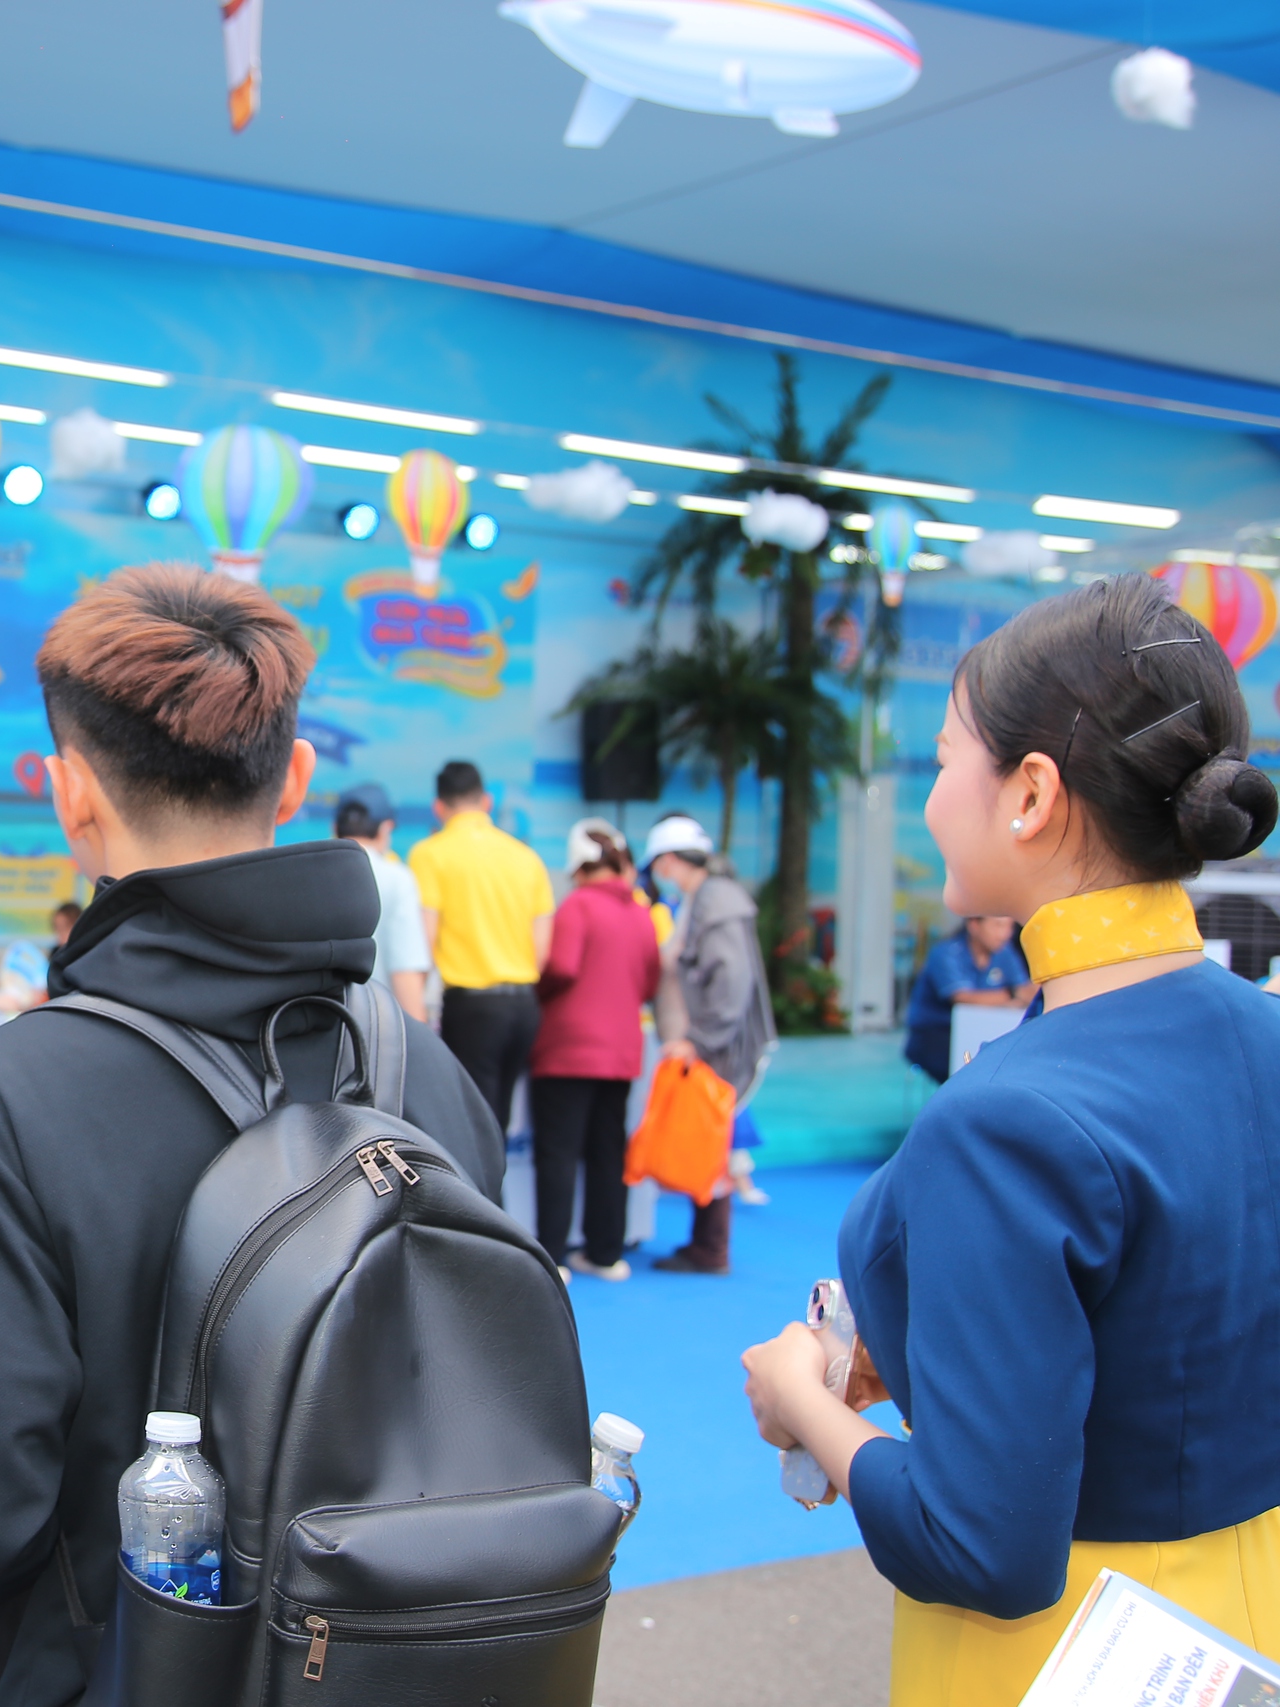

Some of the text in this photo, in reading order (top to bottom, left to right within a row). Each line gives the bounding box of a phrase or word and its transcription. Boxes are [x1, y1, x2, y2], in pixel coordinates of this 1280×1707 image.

[1146, 1652, 1177, 1692] TRÌNH
[1168, 1674, 1193, 1705] BAN
[1182, 1646, 1208, 1678] ĐÊM
[1207, 1658, 1230, 1687] KHU
